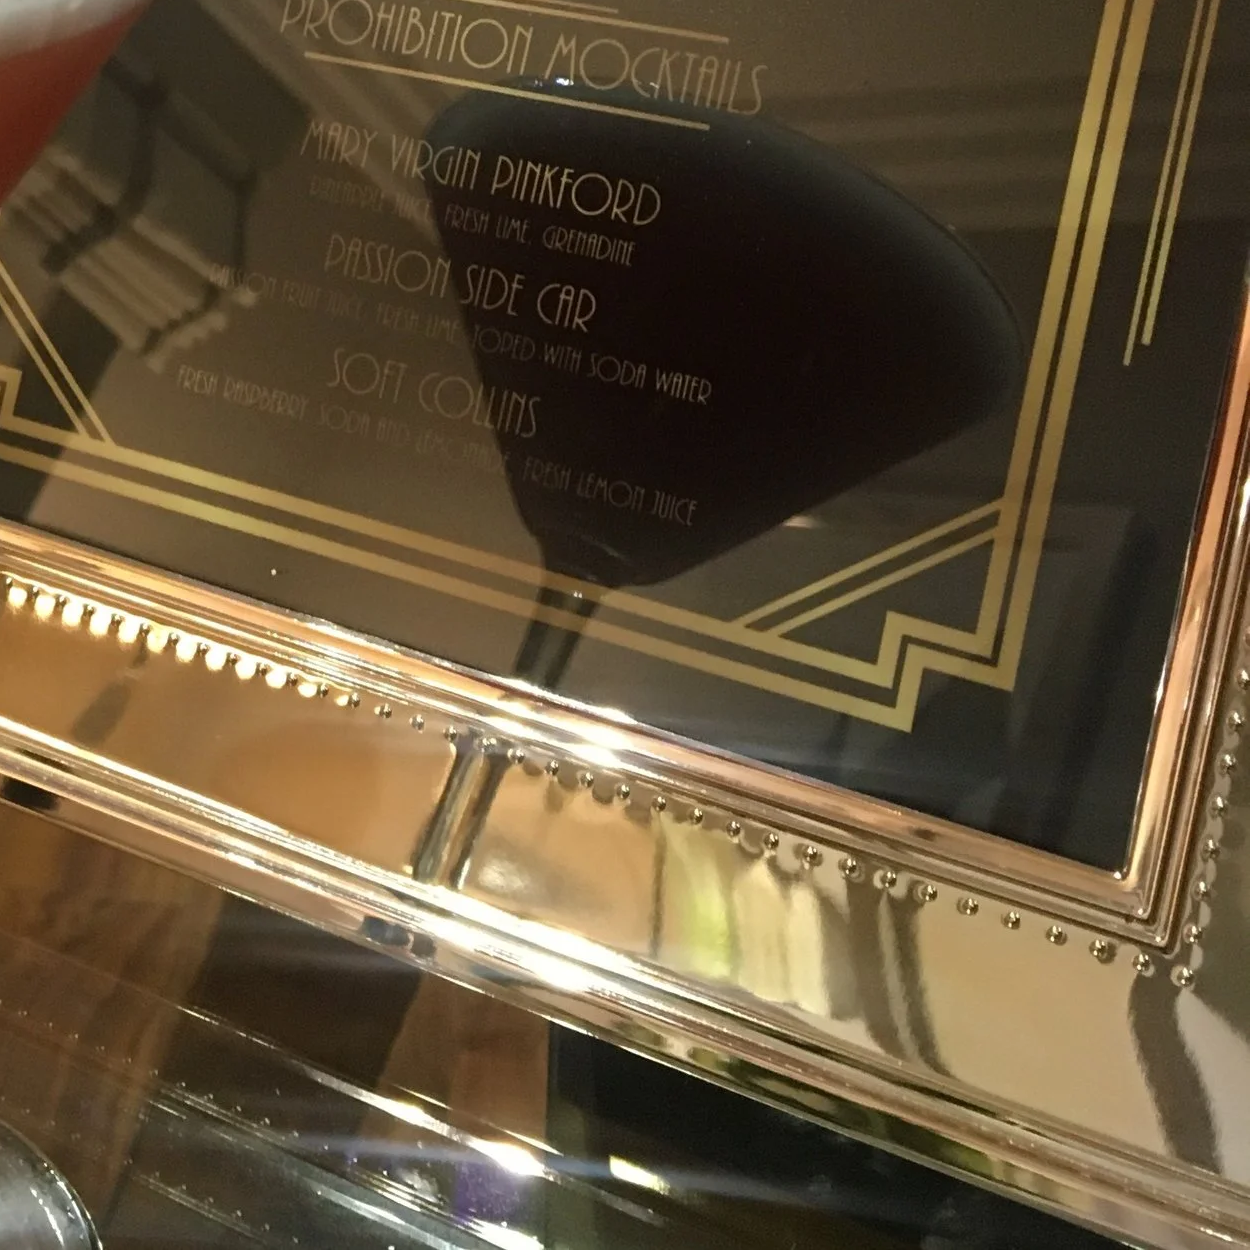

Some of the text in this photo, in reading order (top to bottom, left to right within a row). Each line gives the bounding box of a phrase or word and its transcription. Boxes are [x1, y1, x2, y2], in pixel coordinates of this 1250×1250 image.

[545, 33, 769, 117] MOCKTAILS
[299, 120, 662, 226] MARY VIRGIN PINKFORD
[444, 203, 491, 236] FRESH
[541, 223, 638, 269] GRENADINE
[323, 231, 598, 333] PASSION SIDE CAR
[326, 347, 543, 438] SOFT COLLINS
[586, 352, 648, 390] SODA
[655, 367, 713, 405] WATER
[175, 363, 220, 397] FRESH
[222, 373, 309, 421] RASPBERRY
[521, 454, 572, 493] FRESH
[575, 470, 647, 515] LEMON
[650, 488, 699, 527] JUICE
